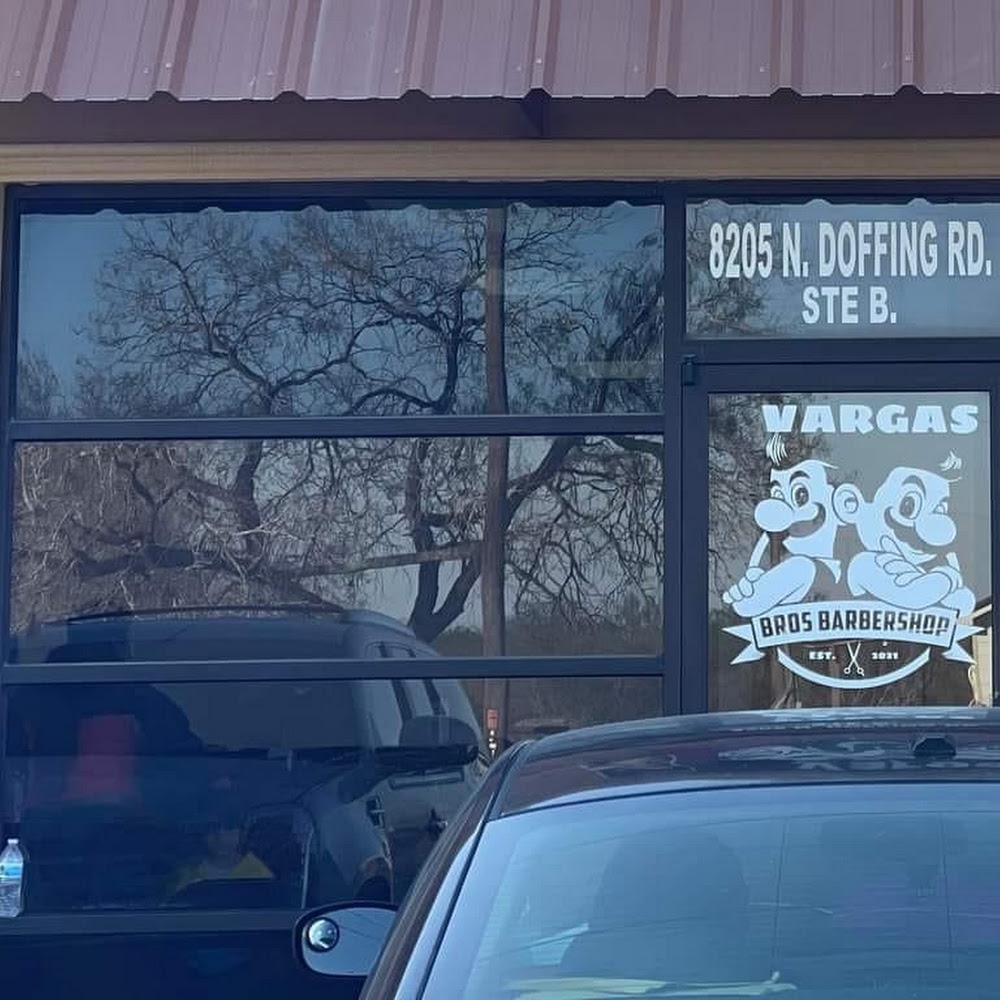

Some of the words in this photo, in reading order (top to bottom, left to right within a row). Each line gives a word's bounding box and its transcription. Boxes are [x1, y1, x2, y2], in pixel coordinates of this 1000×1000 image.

[708, 222, 773, 279] 8205
[782, 222, 809, 278] N.
[818, 221, 938, 277] DOFFING
[948, 221, 992, 276] RD.
[802, 286, 859, 324] STE
[869, 286, 897, 324] B.
[761, 404, 979, 434] VARGAS
[759, 611, 812, 638] BROS
[818, 610, 949, 637] BARBERSHOP
